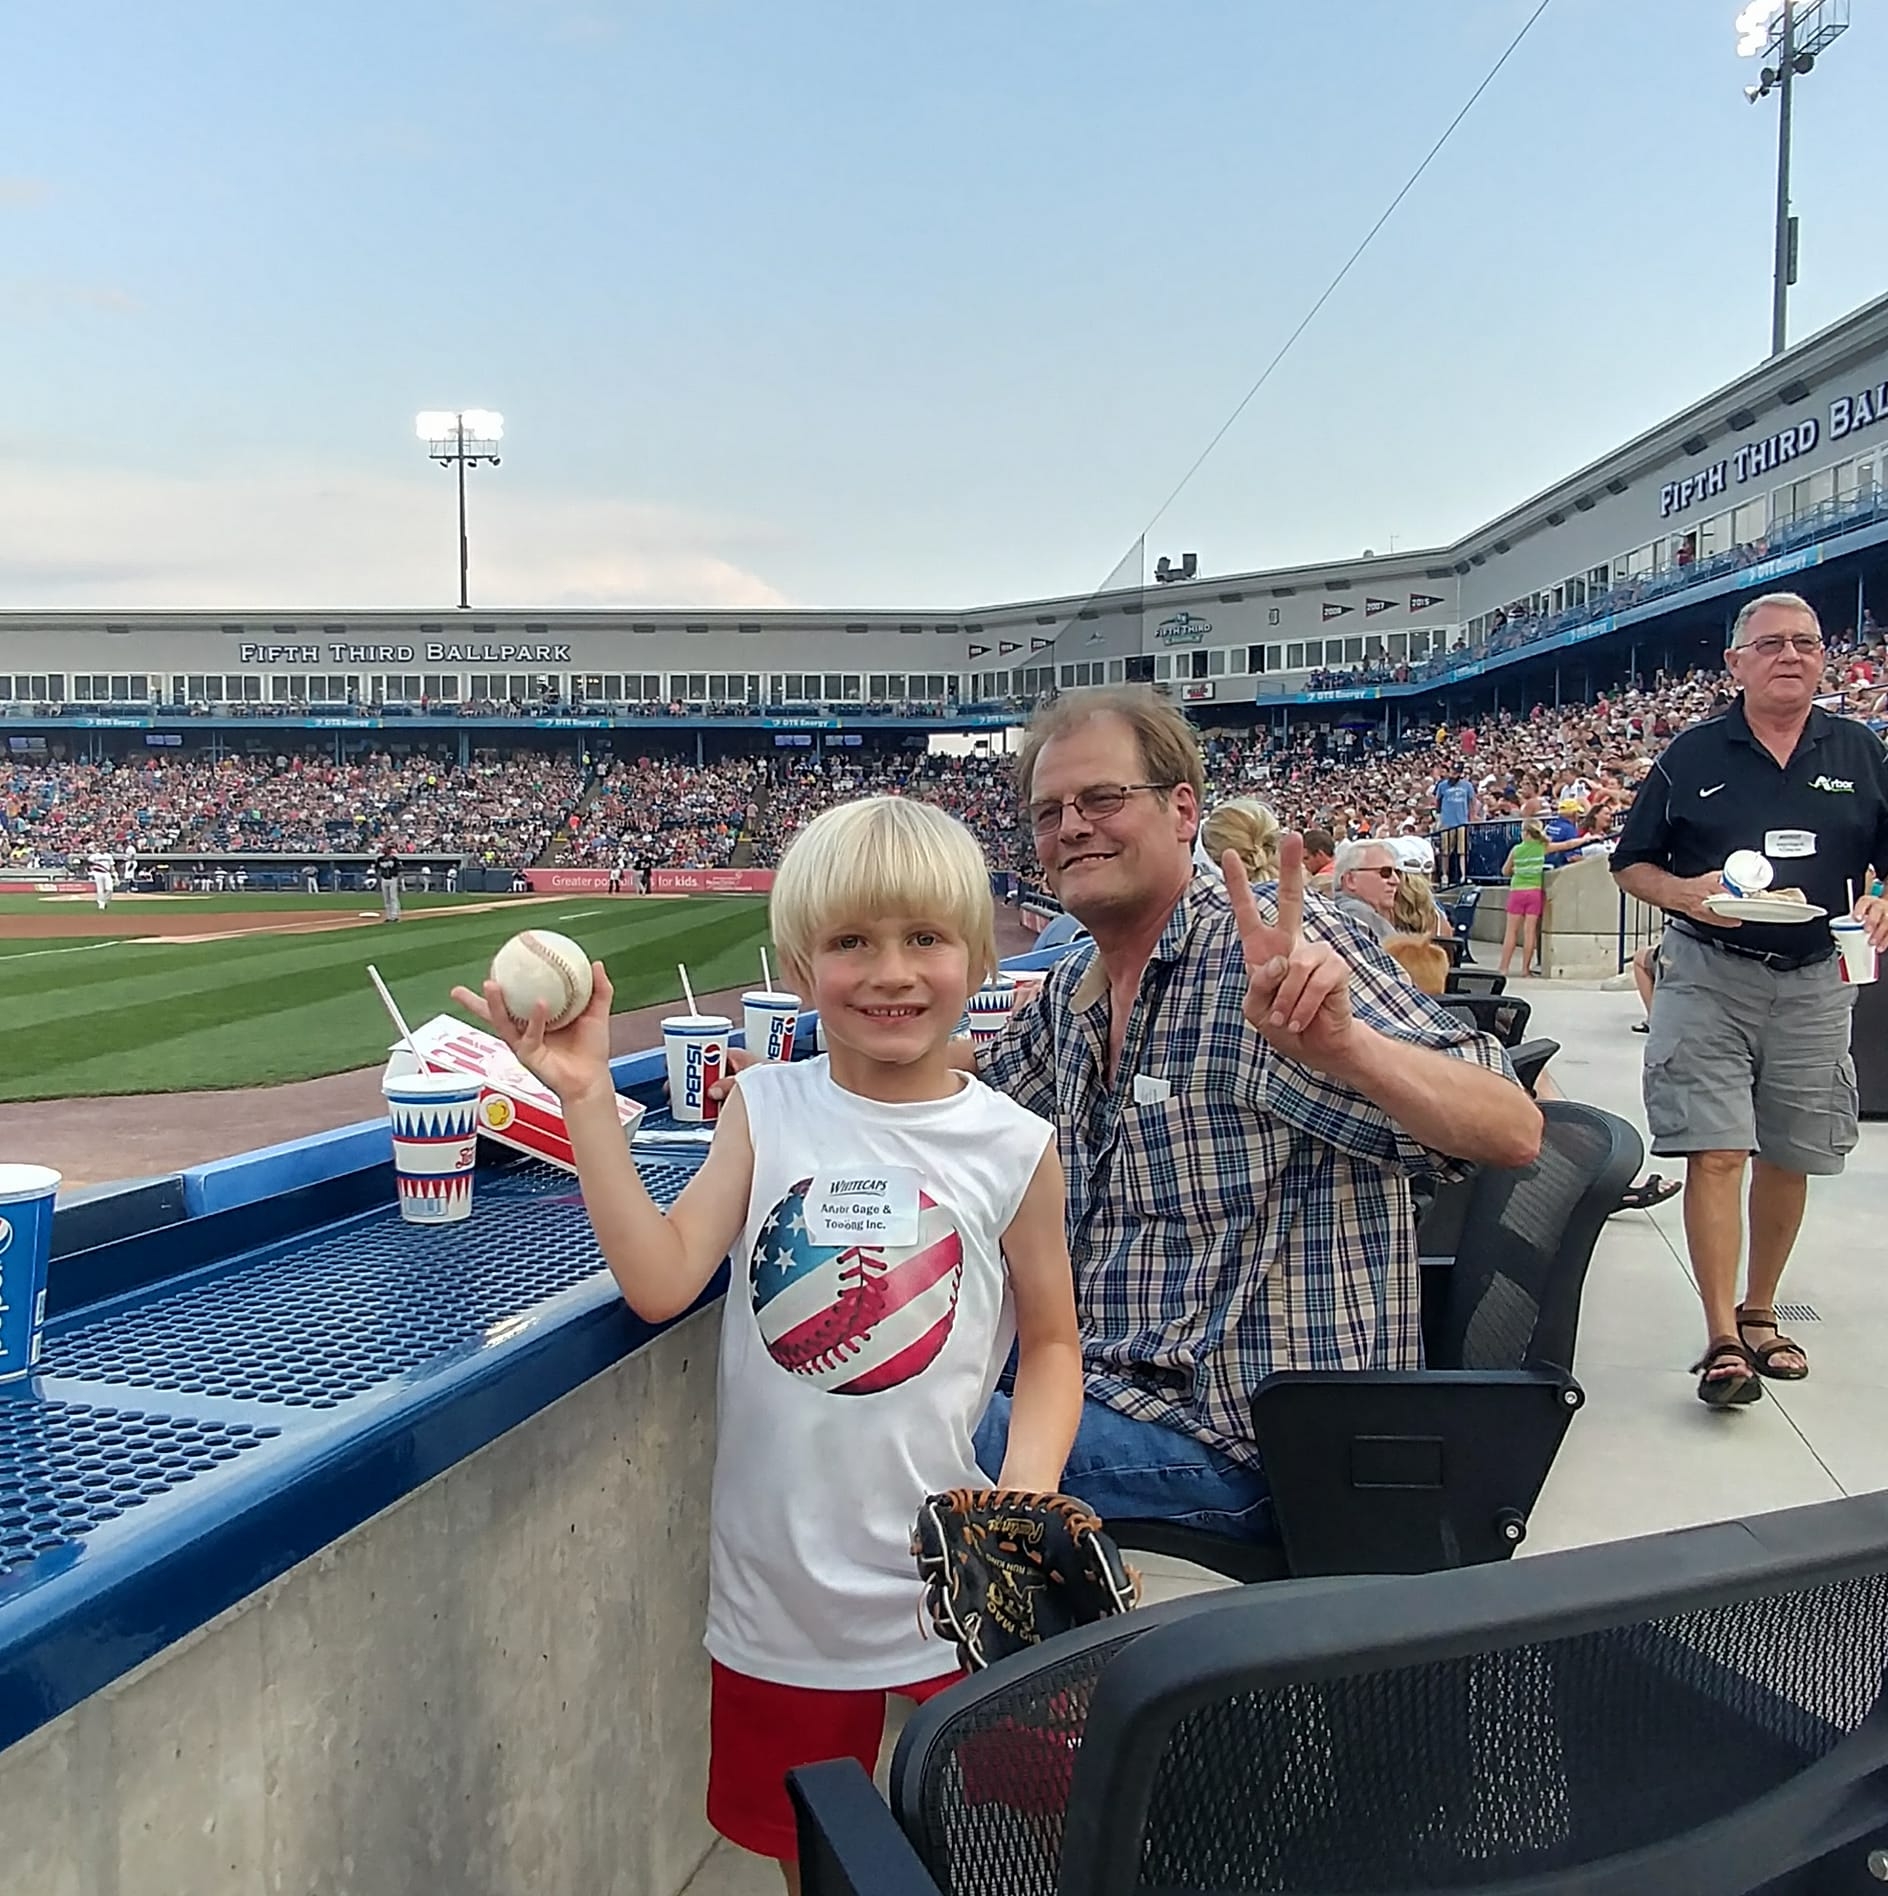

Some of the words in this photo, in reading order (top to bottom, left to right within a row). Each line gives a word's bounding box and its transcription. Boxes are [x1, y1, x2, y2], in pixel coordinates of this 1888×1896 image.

[1659, 460, 1727, 518] FIFTH
[1733, 418, 1819, 484] THIRD
[240, 643, 319, 663] FIFTH
[328, 643, 414, 663] THIRD
[426, 642, 571, 662] BALLPARK
[552, 875, 591, 887] Greater
[658, 876, 673, 886] for
[768, 1016, 784, 1061] EPSI
[686, 1043, 702, 1108] PEPSI
[882, 1204, 892, 1214] &
[866, 1219, 886, 1230] Inc.
